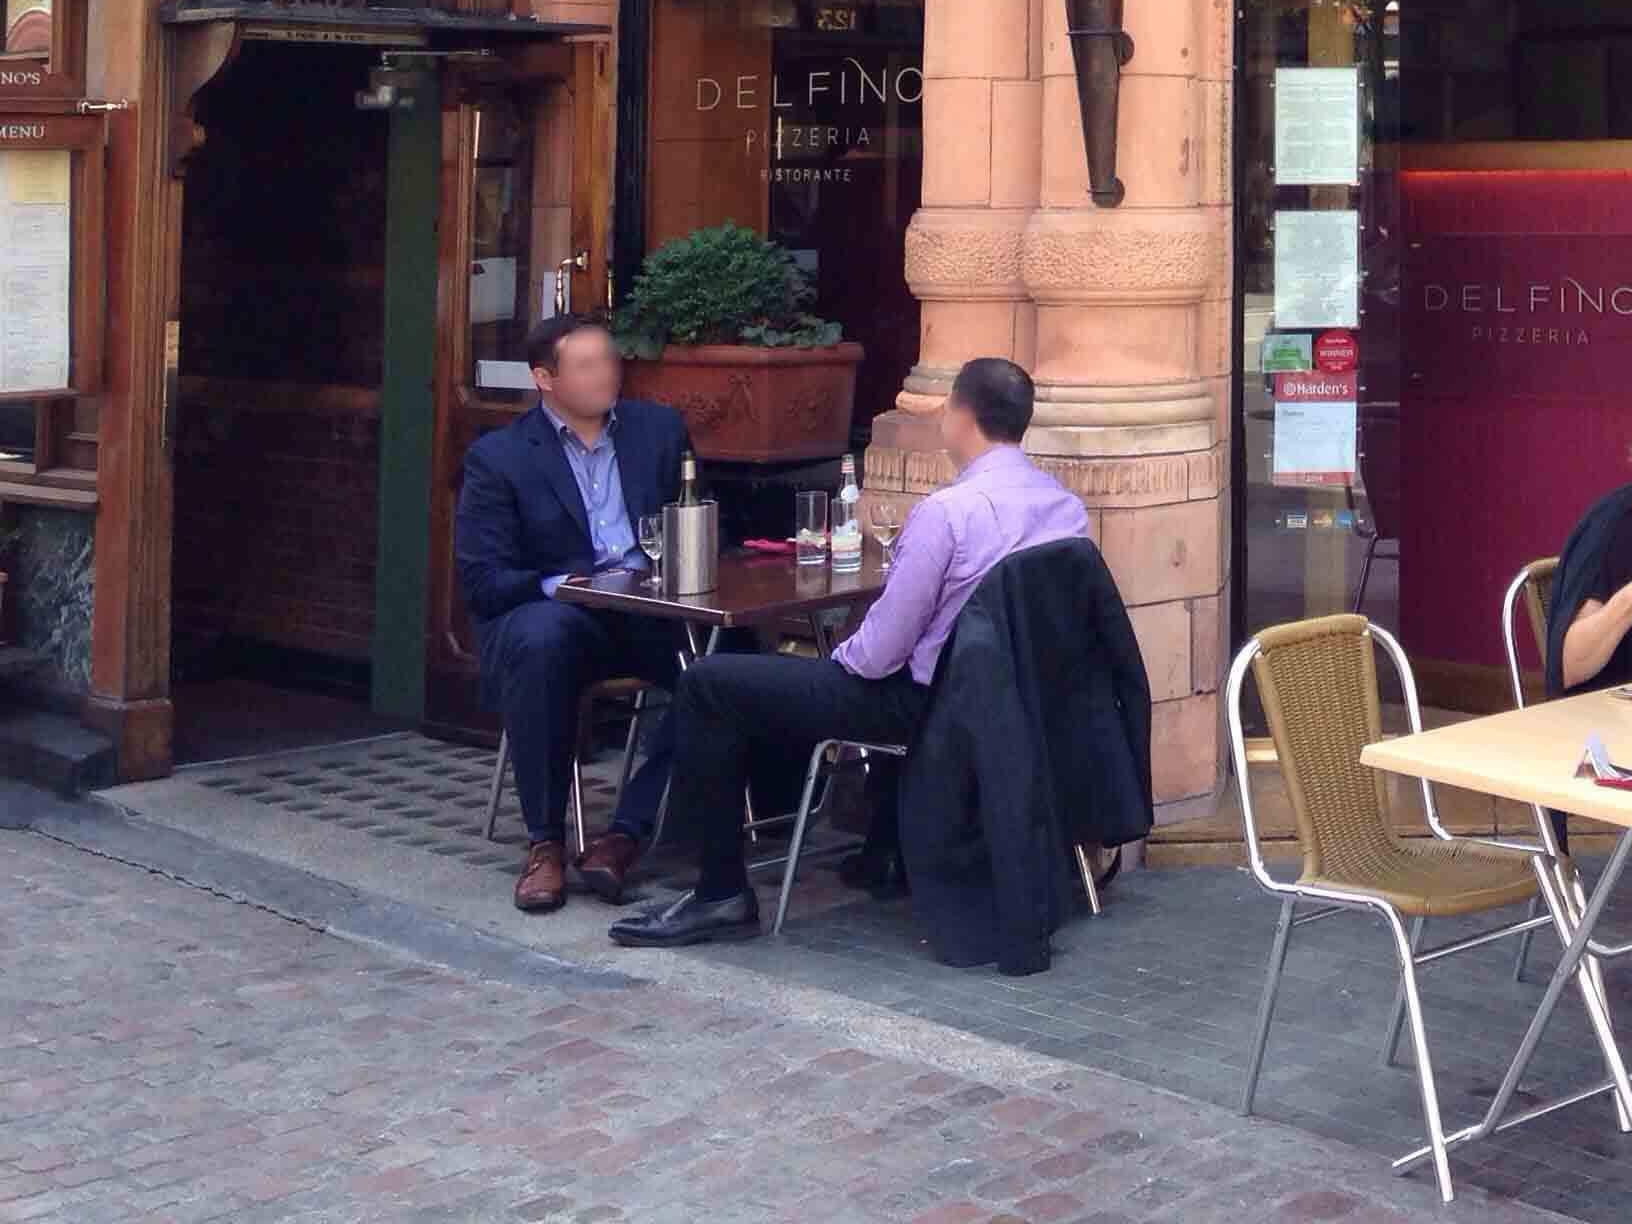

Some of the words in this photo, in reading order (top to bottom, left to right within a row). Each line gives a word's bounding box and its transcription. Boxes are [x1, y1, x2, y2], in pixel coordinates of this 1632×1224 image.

[695, 57, 923, 111] DELFINO
[746, 127, 871, 154] PIZZERIA
[760, 167, 852, 183] RISTORANTE
[1472, 327, 1590, 345] PIZZERIA
[1297, 381, 1349, 396] Harden's
